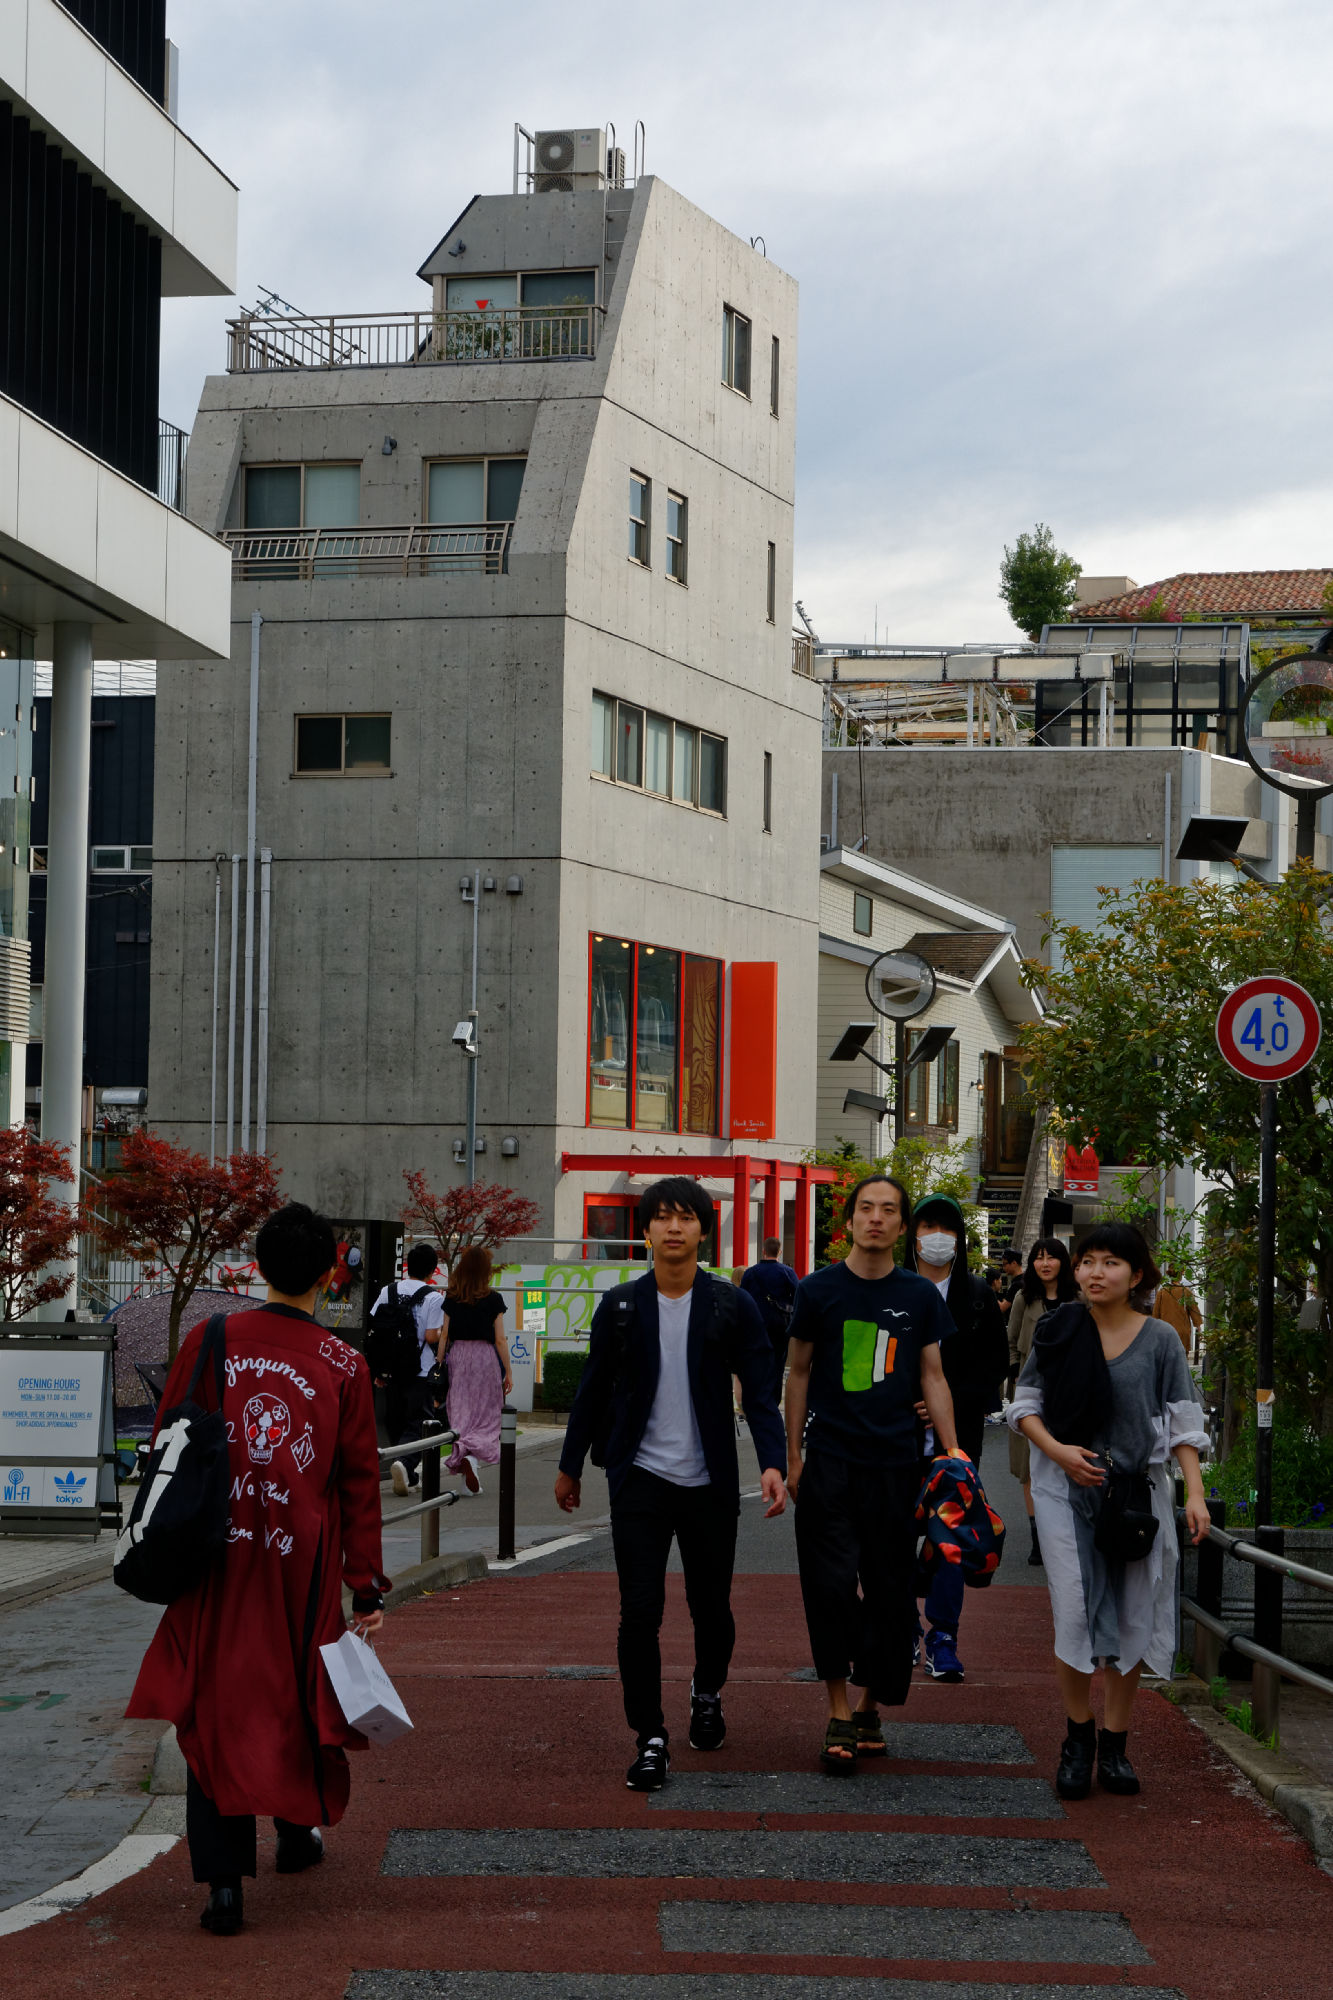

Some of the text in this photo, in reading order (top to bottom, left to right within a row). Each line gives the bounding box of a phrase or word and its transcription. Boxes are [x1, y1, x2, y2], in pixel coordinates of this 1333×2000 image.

[1273, 995, 1285, 1018] t
[1240, 1007, 1289, 1056] 4.0
[327, 1302, 353, 1311] BURTON
[18, 1377, 81, 1390] OPENING HOURS
[55, 1495, 83, 1505] tokyo
